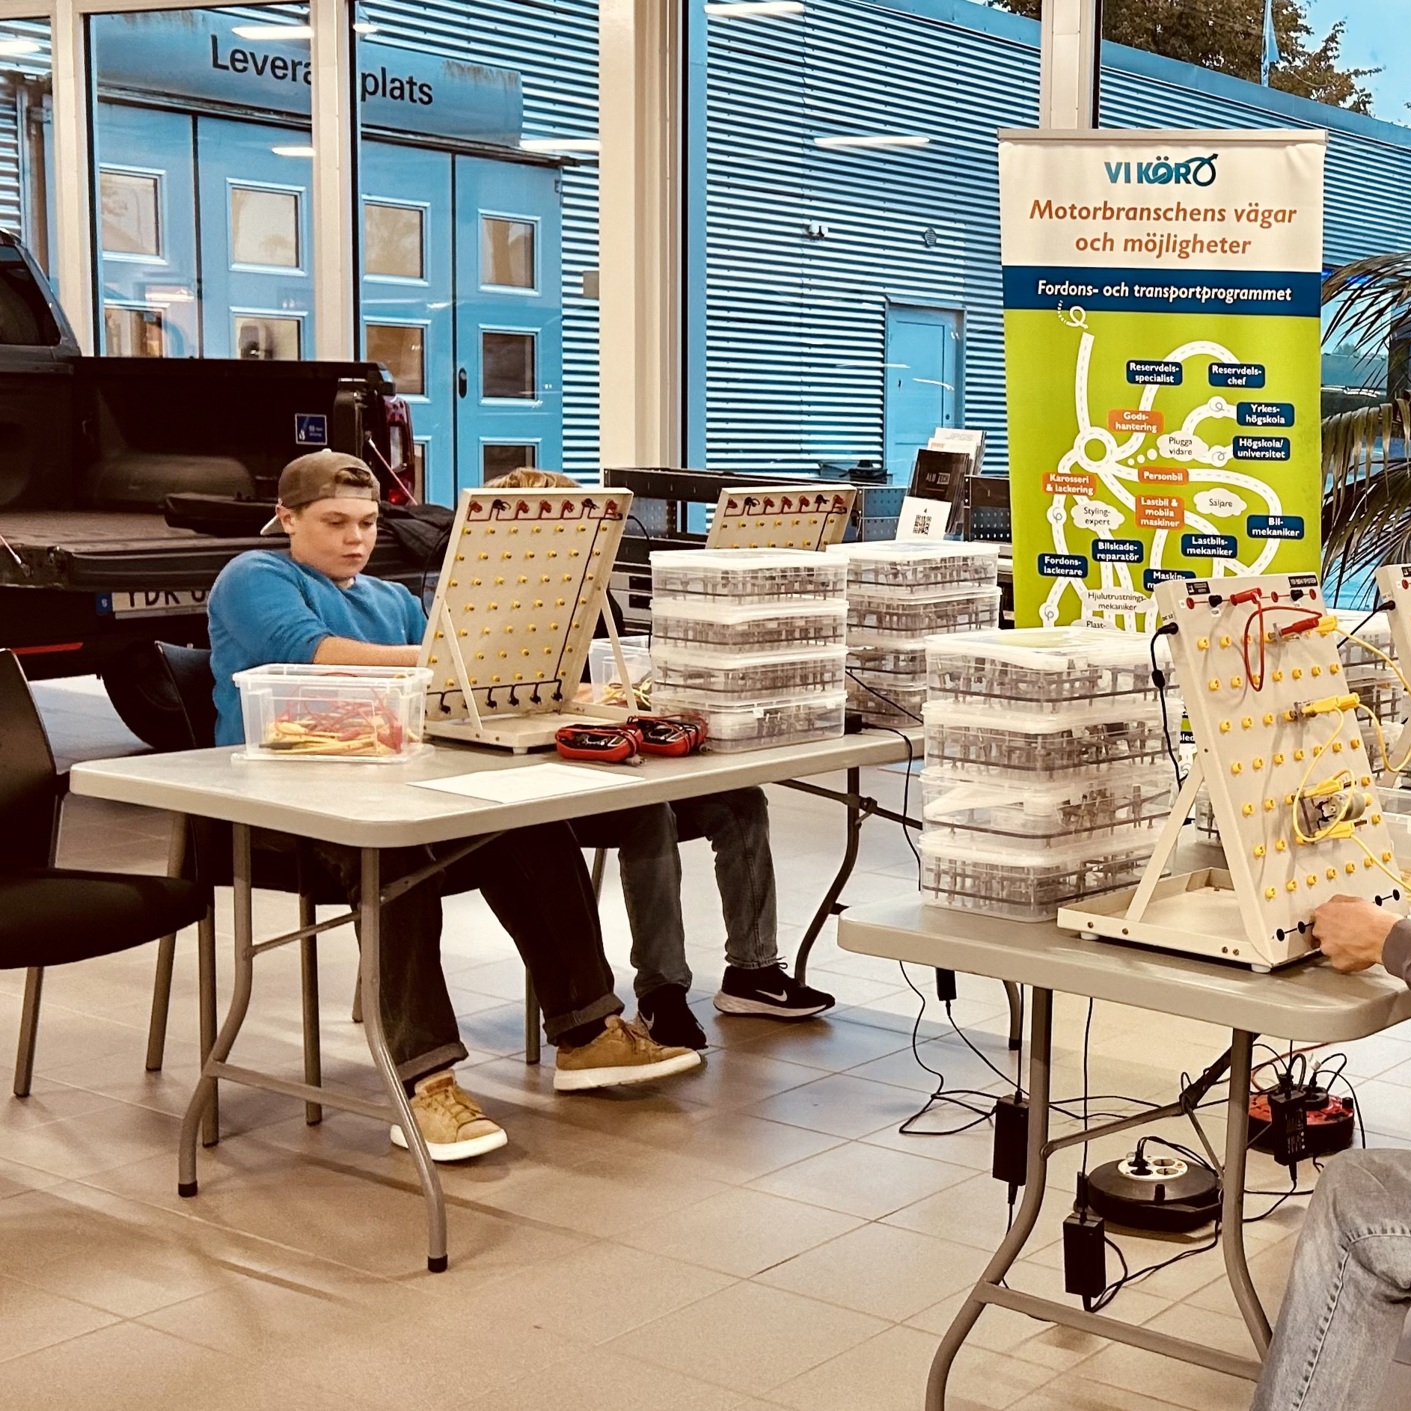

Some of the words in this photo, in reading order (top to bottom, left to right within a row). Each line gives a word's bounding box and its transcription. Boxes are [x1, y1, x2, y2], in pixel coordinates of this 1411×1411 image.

[1104, 162, 1131, 184] VI
[1029, 199, 1227, 222] Motorbranschens
[1234, 203, 1297, 229] vägar
[1075, 232, 1115, 252] och
[1124, 232, 1251, 259] möjligheter
[1037, 280, 1099, 297] Fordons-
[1103, 282, 1129, 297] och
[1133, 283, 1292, 303] transportprogrammet
[1129, 363, 1180, 373] Reservdels-
[1212, 365, 1262, 376] Reservdels-
[1135, 374, 1174, 384] specialist
[1227, 377, 1246, 386] chef
[1251, 404, 1280, 414] Yrkes-
[1123, 411, 1149, 420] Gods-
[1245, 414, 1285, 425] högskola
[1115, 422, 1157, 433] hantering
[1169, 447, 1192, 455] vidare
[1238, 449, 1286, 458] universitet
[1050, 474, 1089, 484] Karosseri
[1144, 471, 1183, 481] Personbil
[1046, 484, 1053, 492] &
[1055, 484, 1094, 496] lackering
[1141, 497, 1169, 506] Lastbil
[1171, 499, 1178, 507] &
[1145, 508, 1174, 517] mobila
[1085, 518, 1110, 527] expert
[1140, 519, 1180, 528] maskiner
[1252, 528, 1300, 537] mekaniker
[1192, 536, 1228, 545] Lastbils-
[1098, 542, 1138, 551] Bilskade-
[1186, 547, 1233, 556] mekaniker
[1044, 556, 1082, 566] Fordons-
[1096, 552, 1139, 562] reparatör
[1043, 567, 1083, 577] lackerare
[1098, 603, 1137, 611] mekaniker
